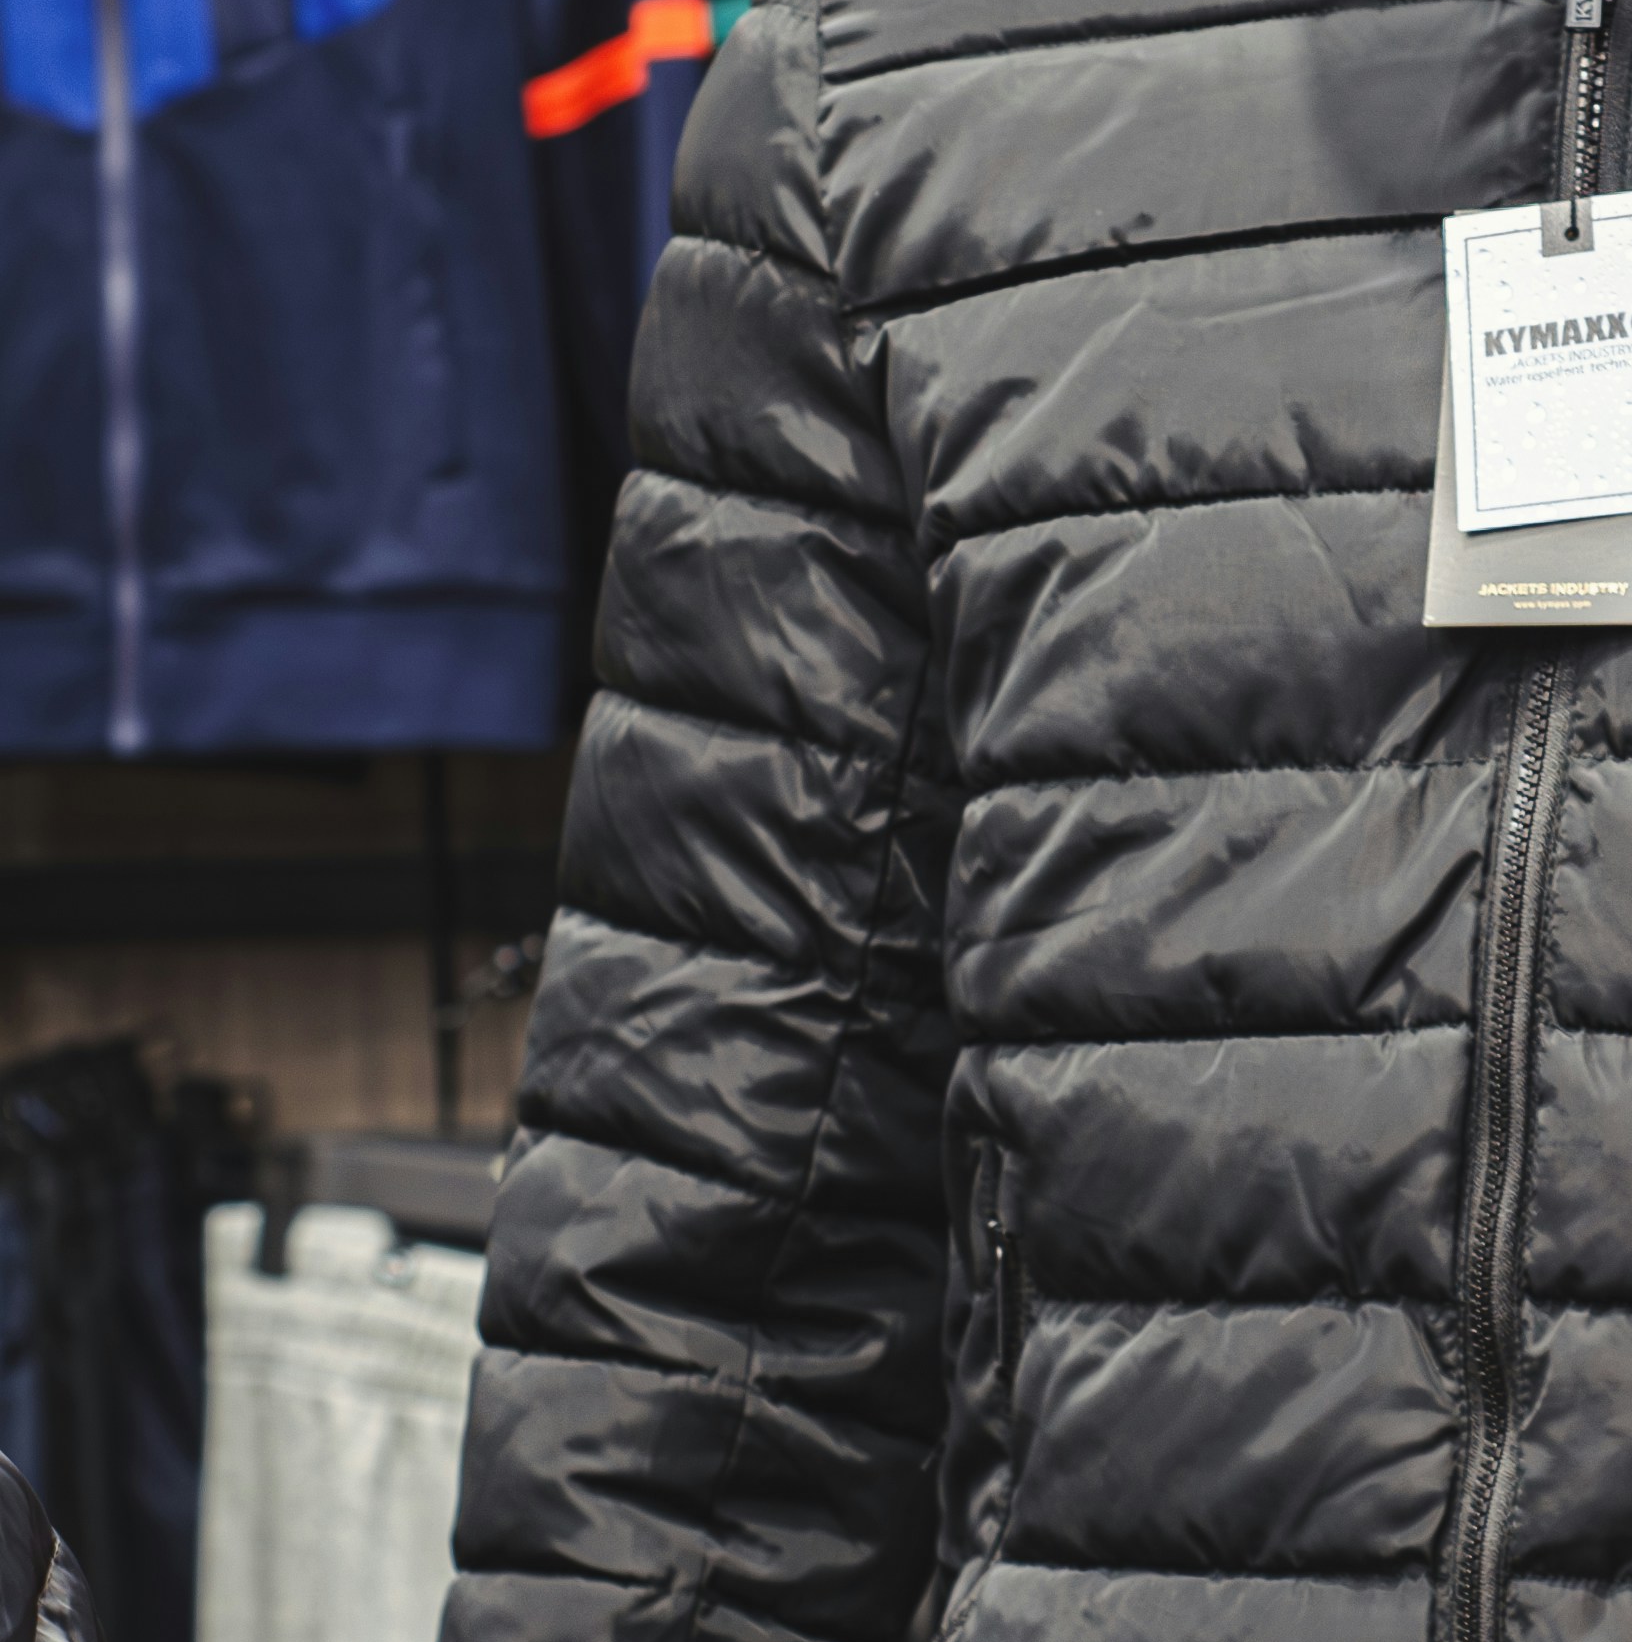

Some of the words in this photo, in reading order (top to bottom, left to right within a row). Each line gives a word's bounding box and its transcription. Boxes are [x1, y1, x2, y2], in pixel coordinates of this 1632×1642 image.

[1511, 352, 1567, 369] JACKETS
[1485, 372, 1523, 388] Water
[1478, 582, 1548, 596] JACKETS
[1551, 582, 1629, 596] INDUSTRY
